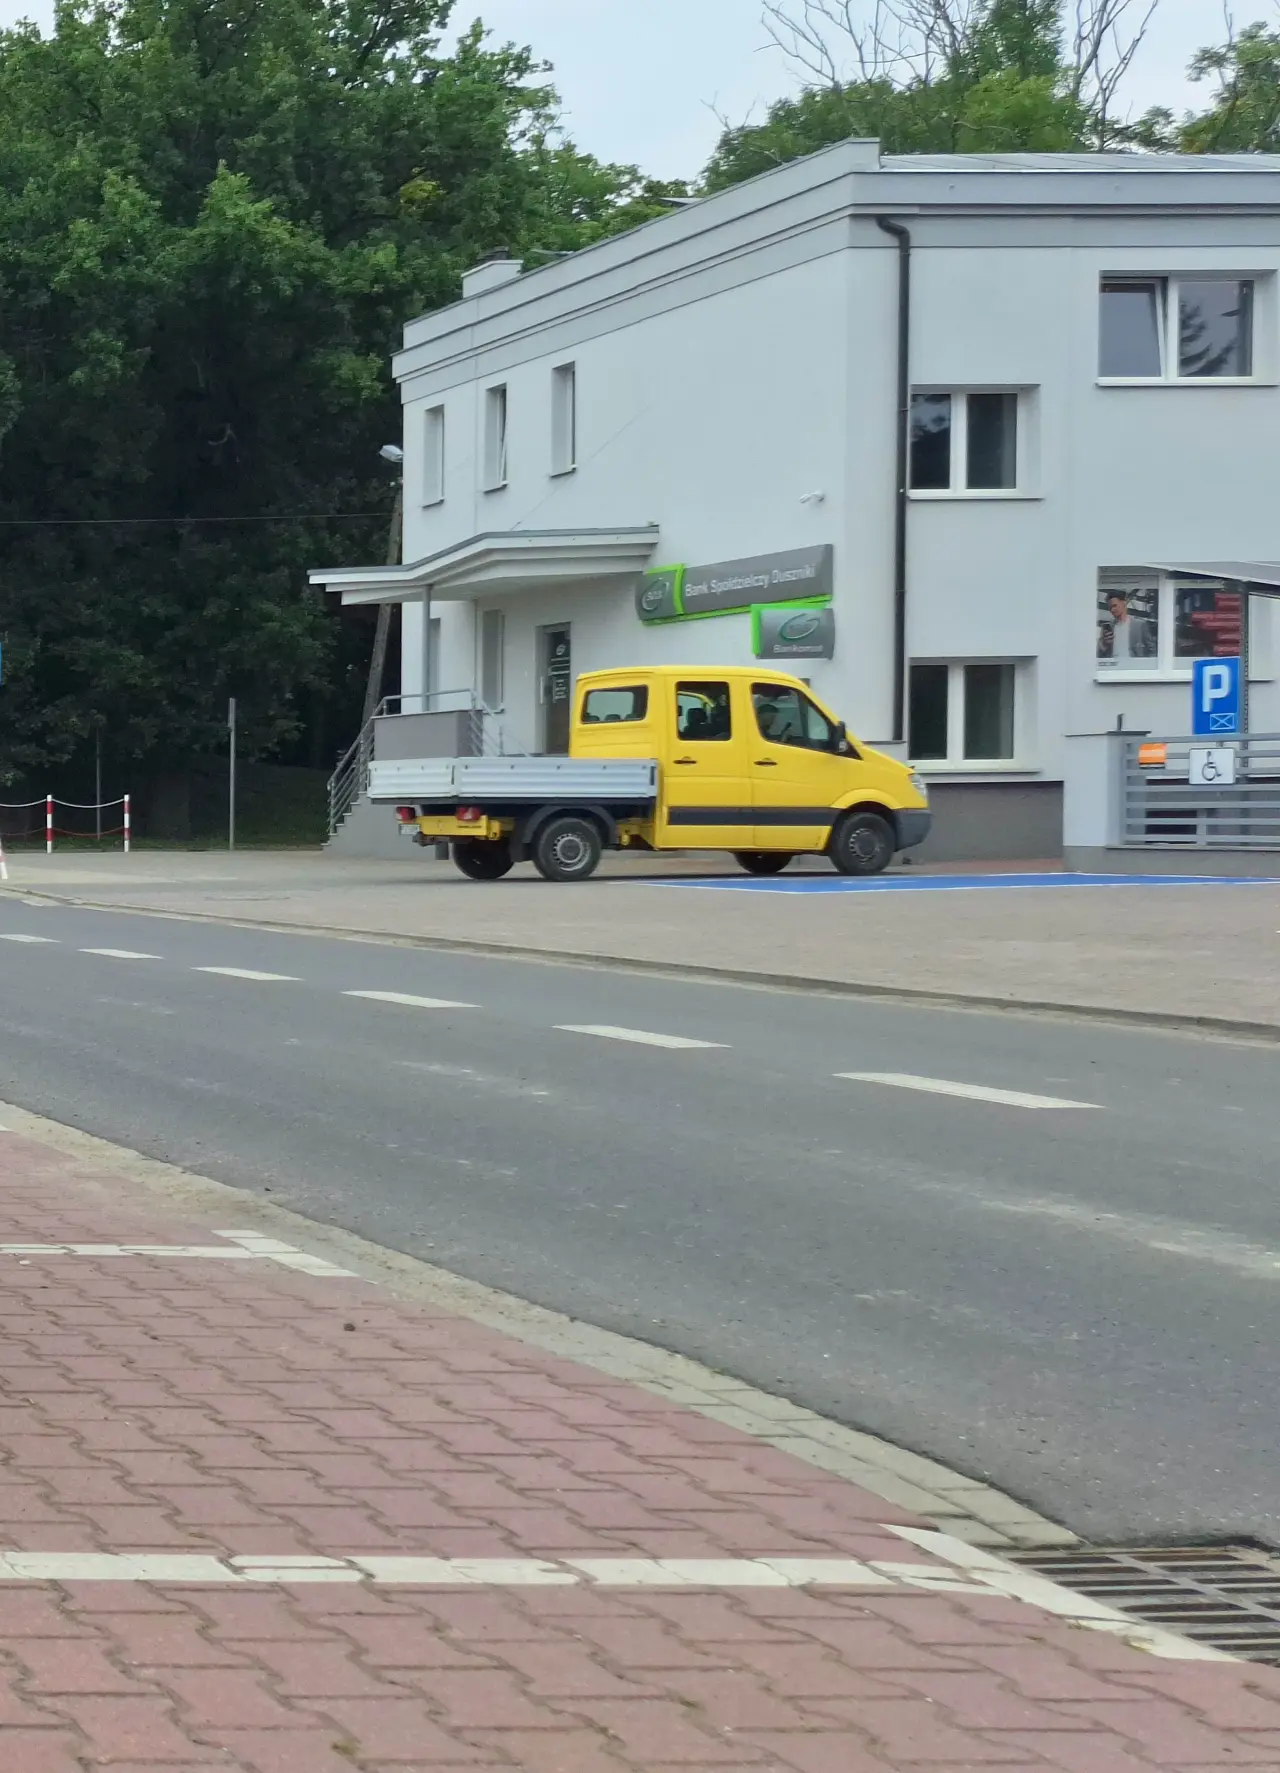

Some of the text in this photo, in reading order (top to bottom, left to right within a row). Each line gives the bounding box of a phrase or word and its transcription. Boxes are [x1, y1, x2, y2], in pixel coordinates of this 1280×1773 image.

[685, 582, 709, 597] Bank
[772, 564, 816, 583] Duszniki
[1202, 664, 1229, 712] P
